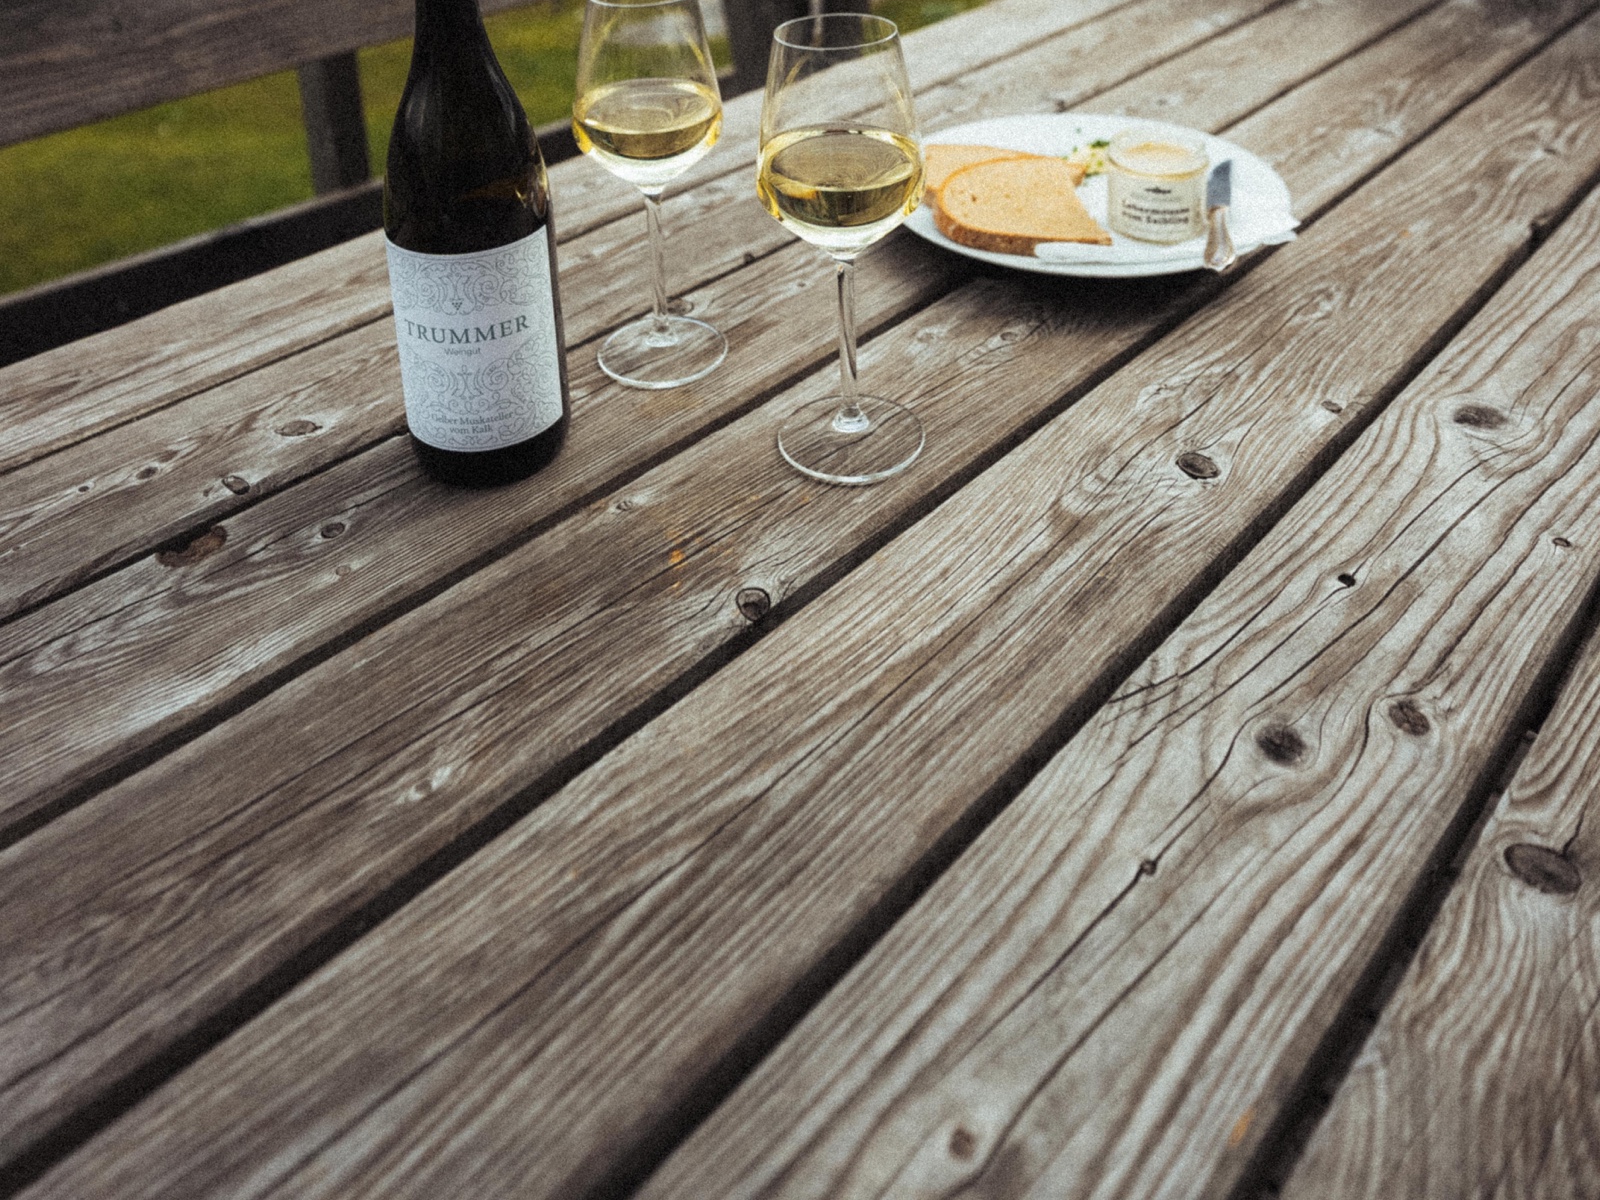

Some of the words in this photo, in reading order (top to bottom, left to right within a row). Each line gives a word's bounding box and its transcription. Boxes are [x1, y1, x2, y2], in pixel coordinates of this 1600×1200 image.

[404, 314, 530, 345] TRUMMER
[444, 347, 481, 358] Weingut
[459, 411, 514, 425] Muskateller
[449, 426, 470, 434] vom
[472, 424, 493, 434] Kalk
